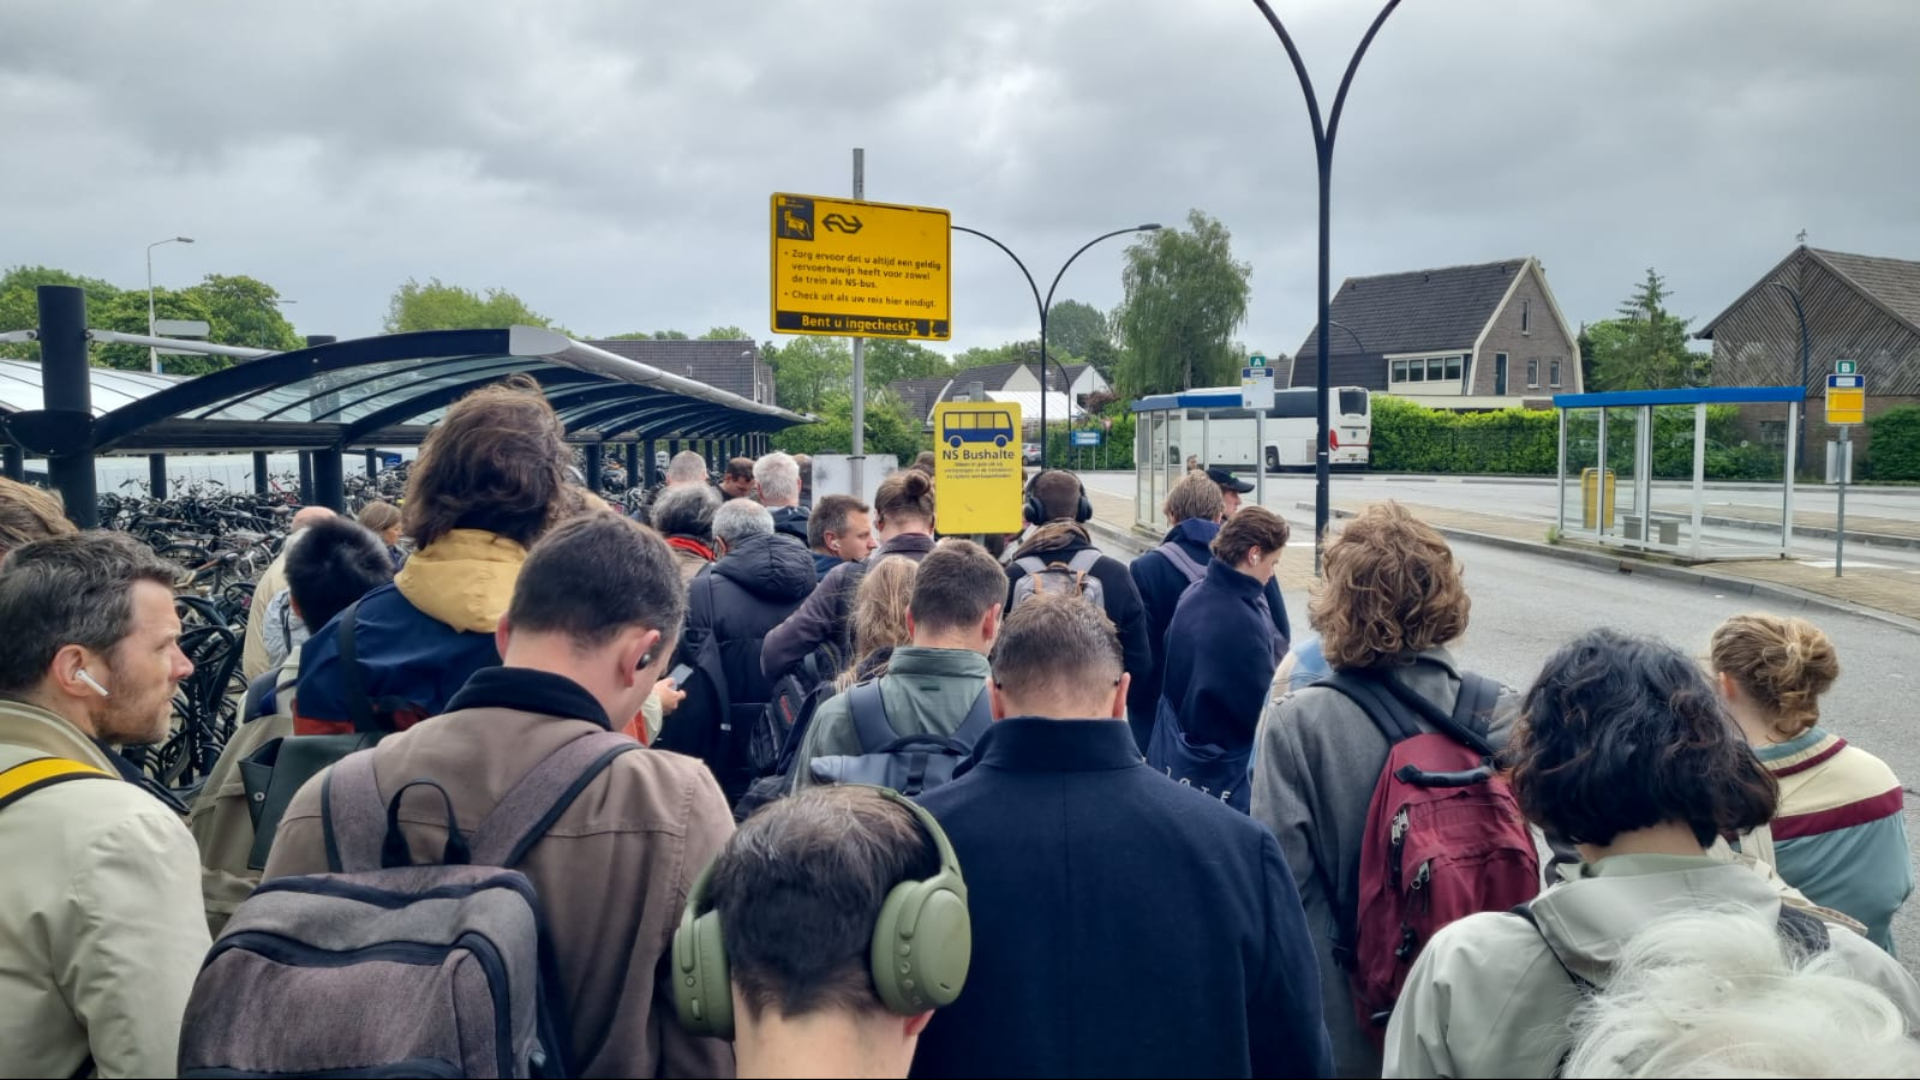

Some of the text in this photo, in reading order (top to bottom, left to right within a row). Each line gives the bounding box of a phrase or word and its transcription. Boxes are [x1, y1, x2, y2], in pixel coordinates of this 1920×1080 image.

[792, 249, 813, 261] Zorg
[816, 252, 845, 262] ervoor
[873, 255, 895, 267] altijd
[915, 260, 942, 271] geldig
[792, 264, 855, 276] vervoerbewijs
[857, 268, 881, 277] heeft
[905, 272, 931, 280] zowel
[792, 274, 804, 283] de
[806, 276, 828, 285] trein
[830, 277, 843, 286] als
[792, 290, 819, 301] Check
[821, 292, 834, 302] uit
[836, 293, 849, 303] als
[867, 296, 884, 305] reis
[885, 296, 903, 306] hier
[904, 298, 937, 309] eindigt.
[802, 315, 916, 333] Bent u ingecheckt?
[1254, 358, 1262, 367] A
[1841, 363, 1850, 372] B
[943, 449, 1014, 460] NS Bushalte
